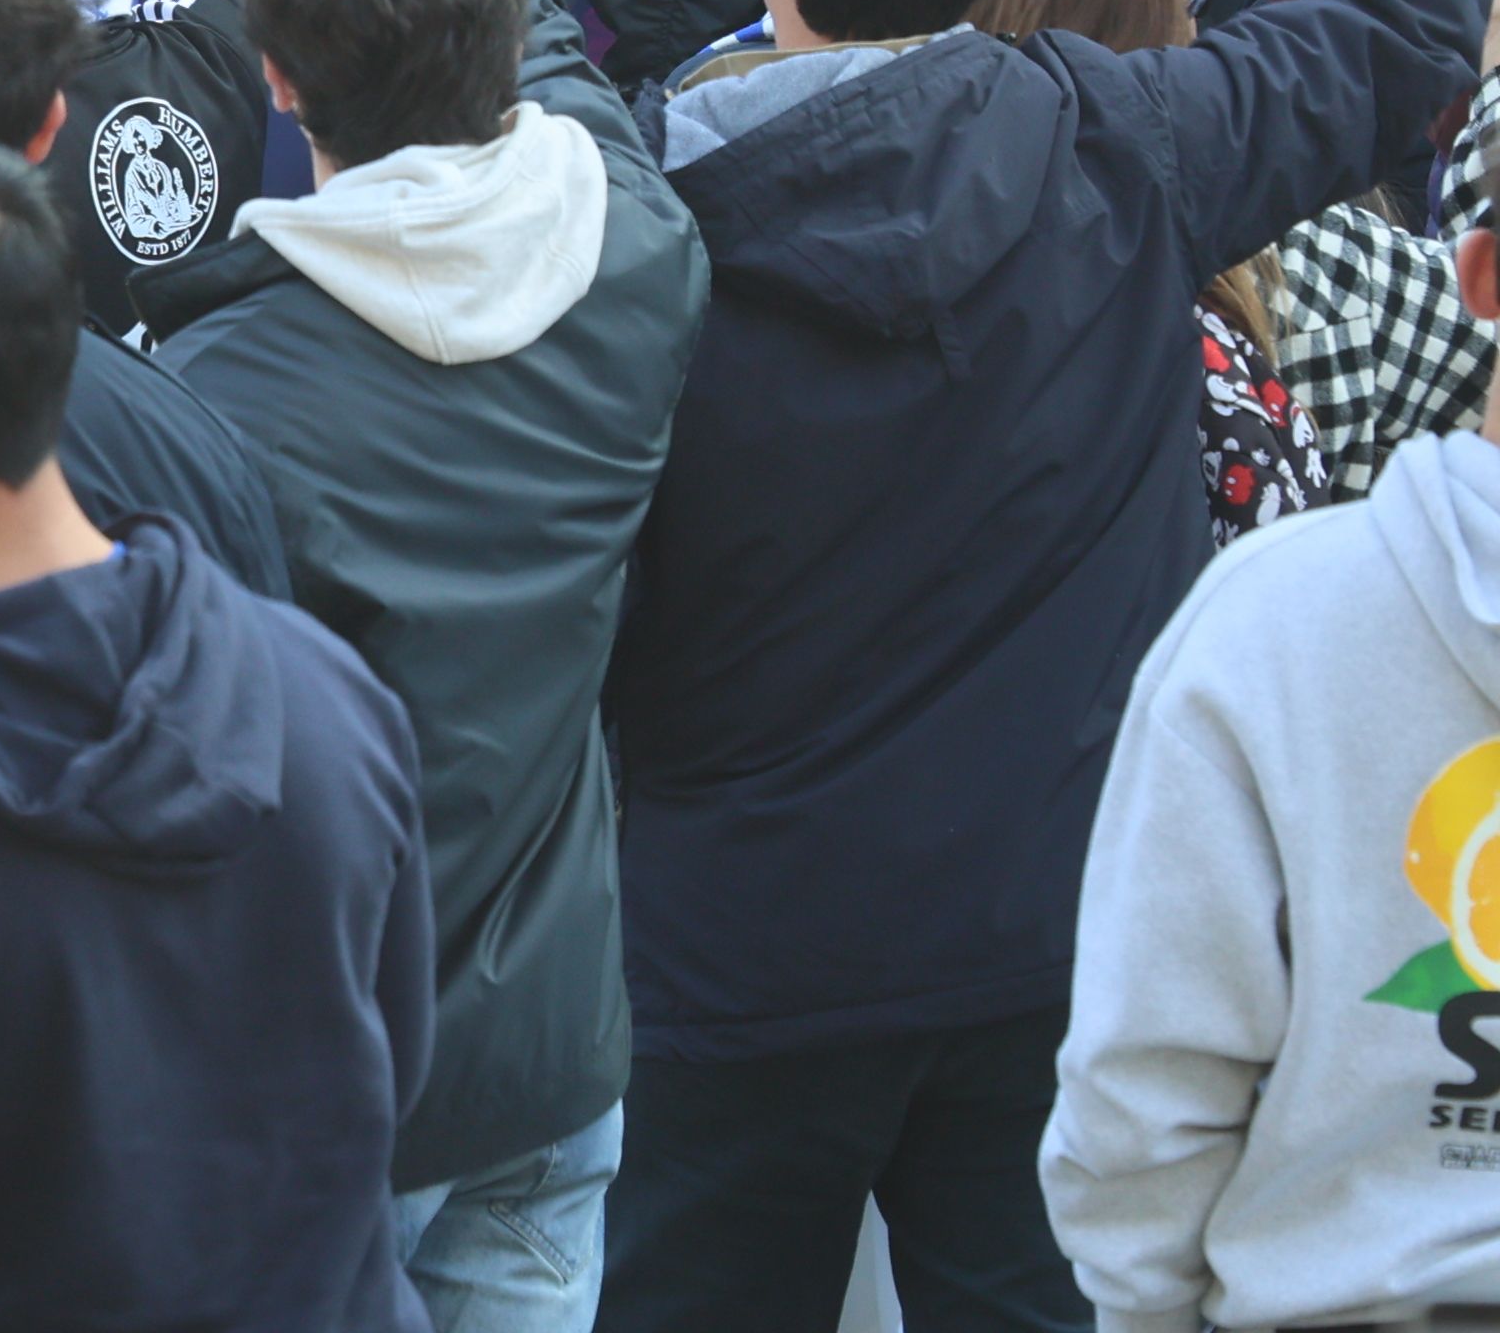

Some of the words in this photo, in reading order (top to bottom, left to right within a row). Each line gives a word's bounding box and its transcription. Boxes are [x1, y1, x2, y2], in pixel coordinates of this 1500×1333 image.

[97, 119, 128, 240] WILLIAMS
[158, 106, 214, 213] HUMBERT
[136, 241, 169, 256] ESTD
[171, 229, 192, 252] 1877
[1429, 1105, 1500, 1133] SE
